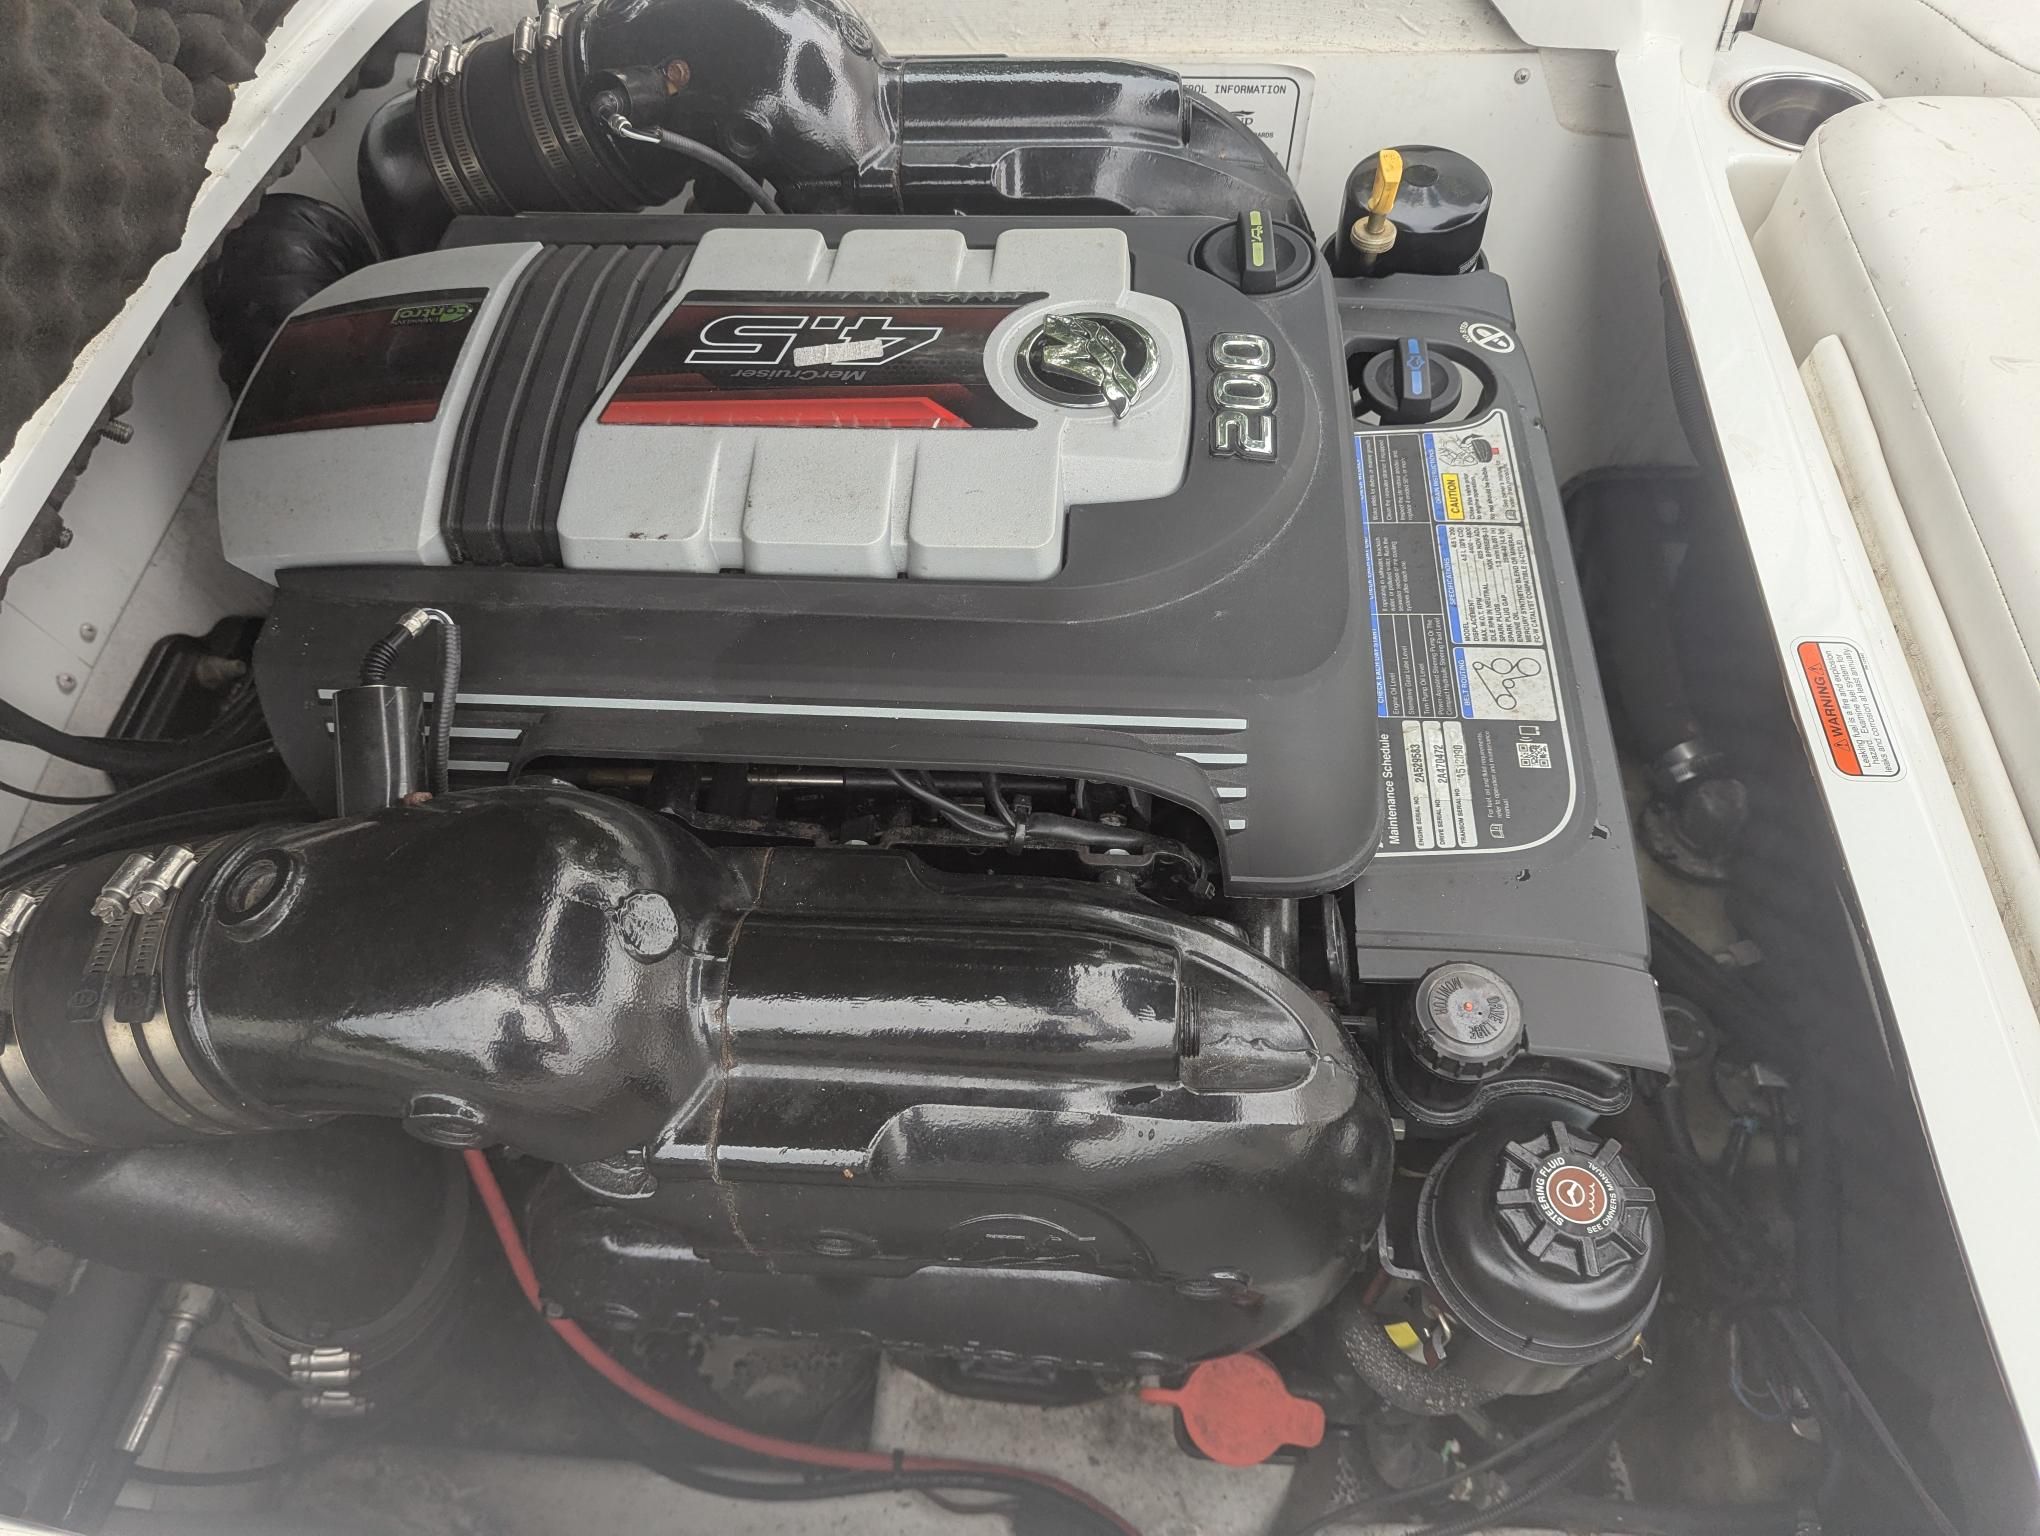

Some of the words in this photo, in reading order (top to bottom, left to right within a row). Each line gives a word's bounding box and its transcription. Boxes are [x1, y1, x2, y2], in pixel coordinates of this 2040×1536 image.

[1215, 84, 1287, 94] INFORMATION
[683, 315, 943, 365] 4.5
[730, 368, 866, 380] MerCruiser
[1210, 331, 1275, 459] 200
[1446, 479, 1460, 513] CAUTION
[1443, 557, 1455, 604] SPECIFICATIONS
[1824, 650, 1842, 682] explosion
[1834, 654, 1843, 662] for
[1458, 659, 1467, 688] ROUTING
[1838, 664, 1854, 687] system
[1851, 678, 1864, 693] least
[1462, 689, 1470, 705] BELT
[1834, 683, 1846, 696] and
[1840, 698, 1850, 709] fire
[1847, 689, 1857, 701] fuel
[1813, 676, 1844, 736] WARNING
[1852, 703, 1869, 733] Examine
[1860, 703, 1879, 735] corrosion
[1849, 724, 1860, 736] fuel
[1377, 733, 1393, 777] Schedule
[1854, 739, 1872, 767] Leaking
[1872, 738, 1885, 751] and
[1410, 744, 1425, 782] 2A529583
[1432, 744, 1448, 783] 2A470472
[1879, 754, 1893, 772] leaks
[1381, 780, 1400, 844] Maintenance
[1487, 996, 1504, 1024] DRIVE
[1540, 1157, 1565, 1177] FLUID
[1587, 1161, 1614, 1191] MANUAL
[1536, 1178, 1564, 1226] STEERING
[1602, 1192, 1617, 1226] OWNERS
[1586, 1224, 1604, 1234] SEE
